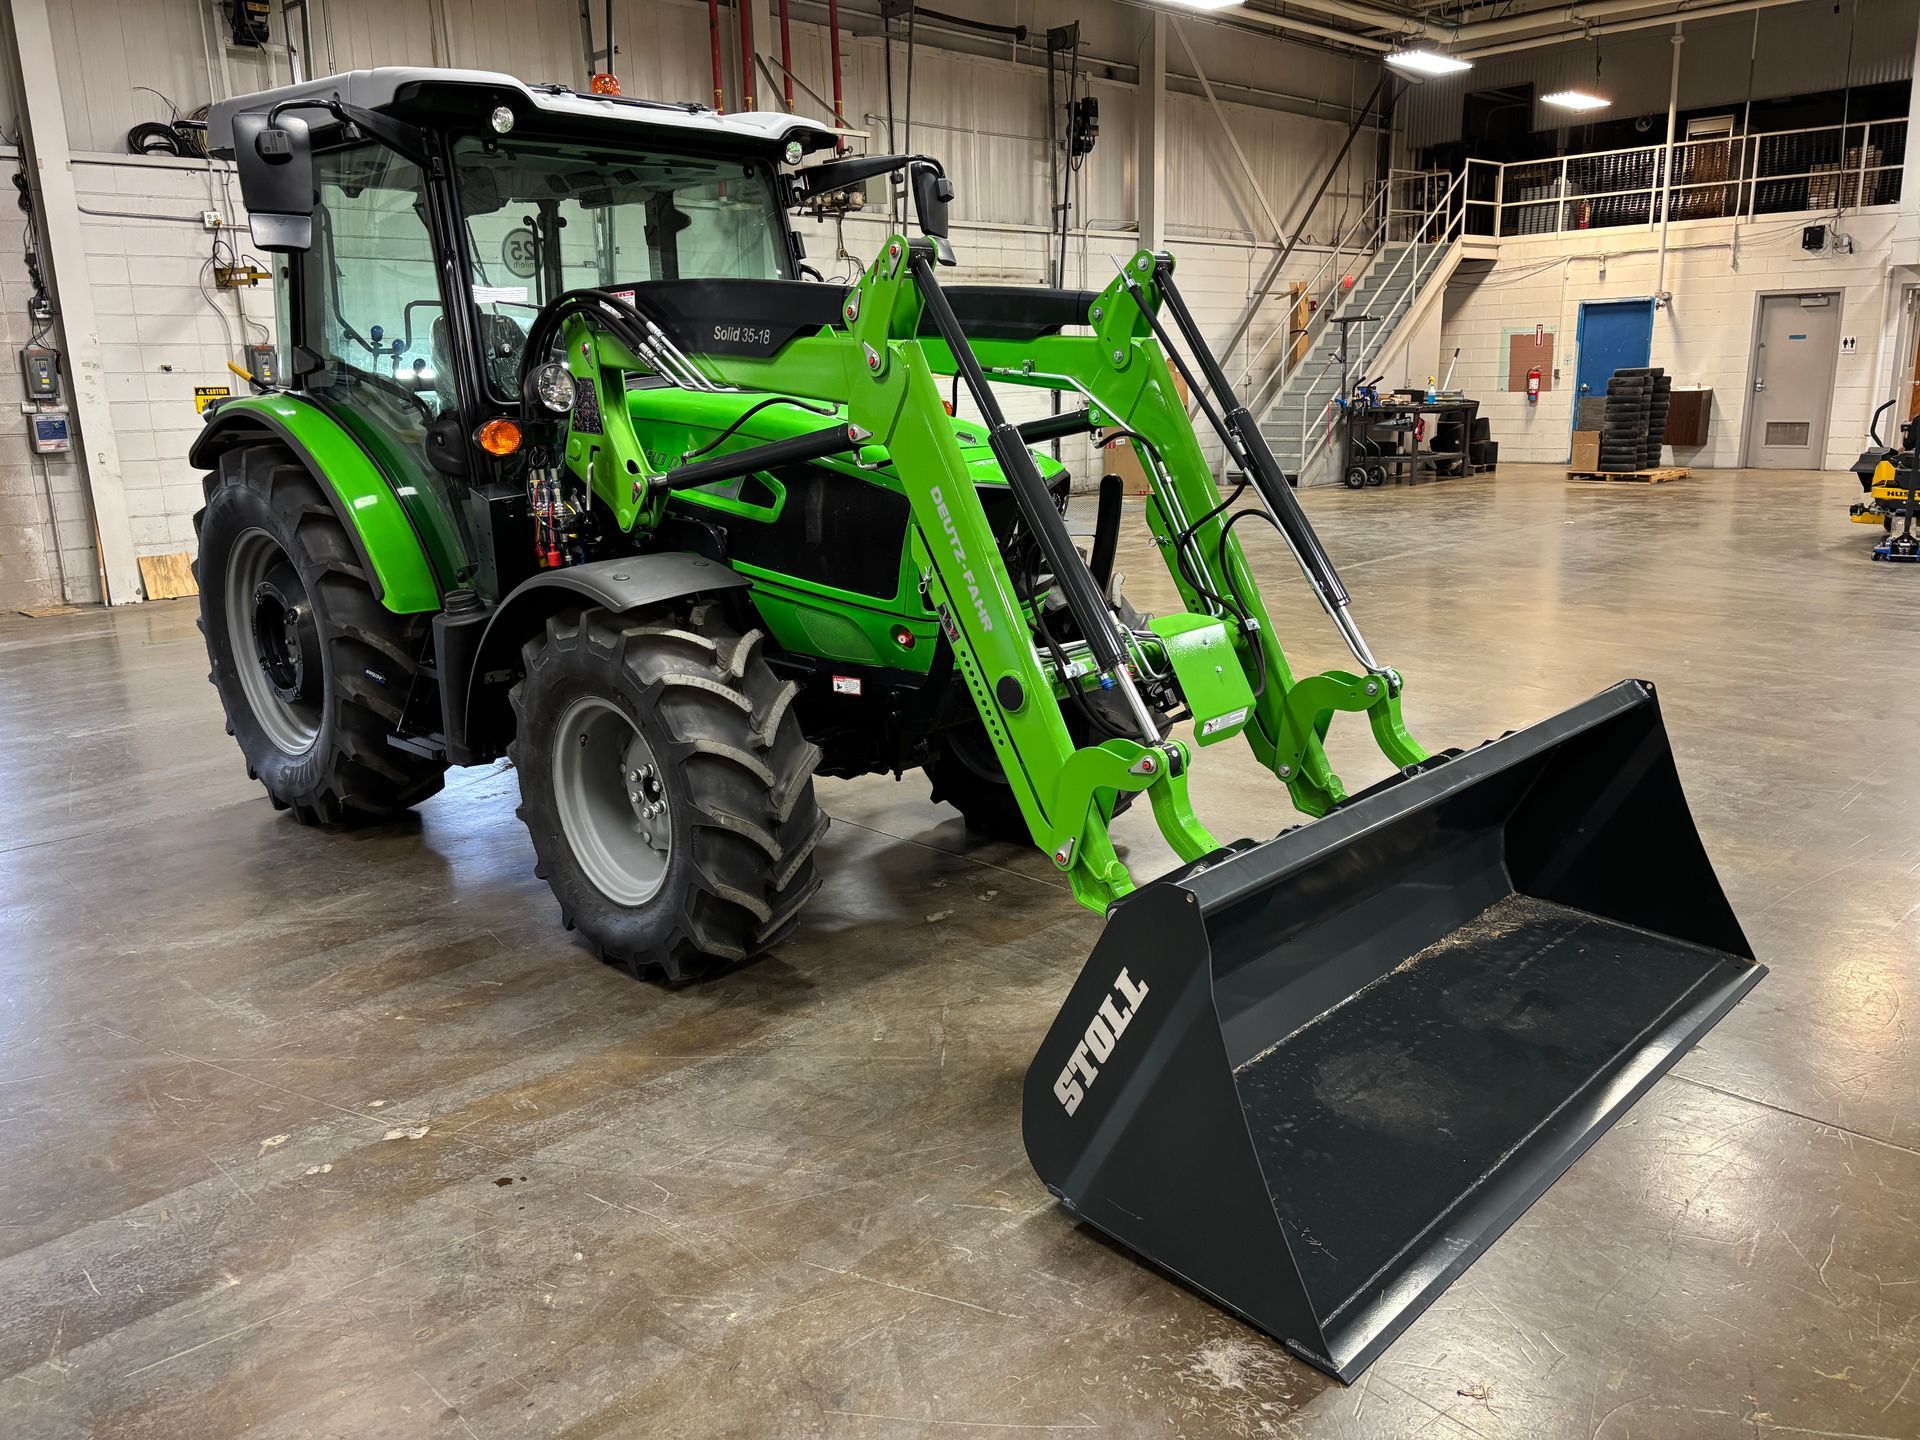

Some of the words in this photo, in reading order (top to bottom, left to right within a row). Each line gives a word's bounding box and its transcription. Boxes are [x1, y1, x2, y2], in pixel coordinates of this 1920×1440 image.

[713, 325, 741, 341] Solid
[741, 327, 771, 345] 35-18
[930, 485, 993, 633] DEUTZ-FAHR
[1053, 966, 1150, 1118] STOLL
